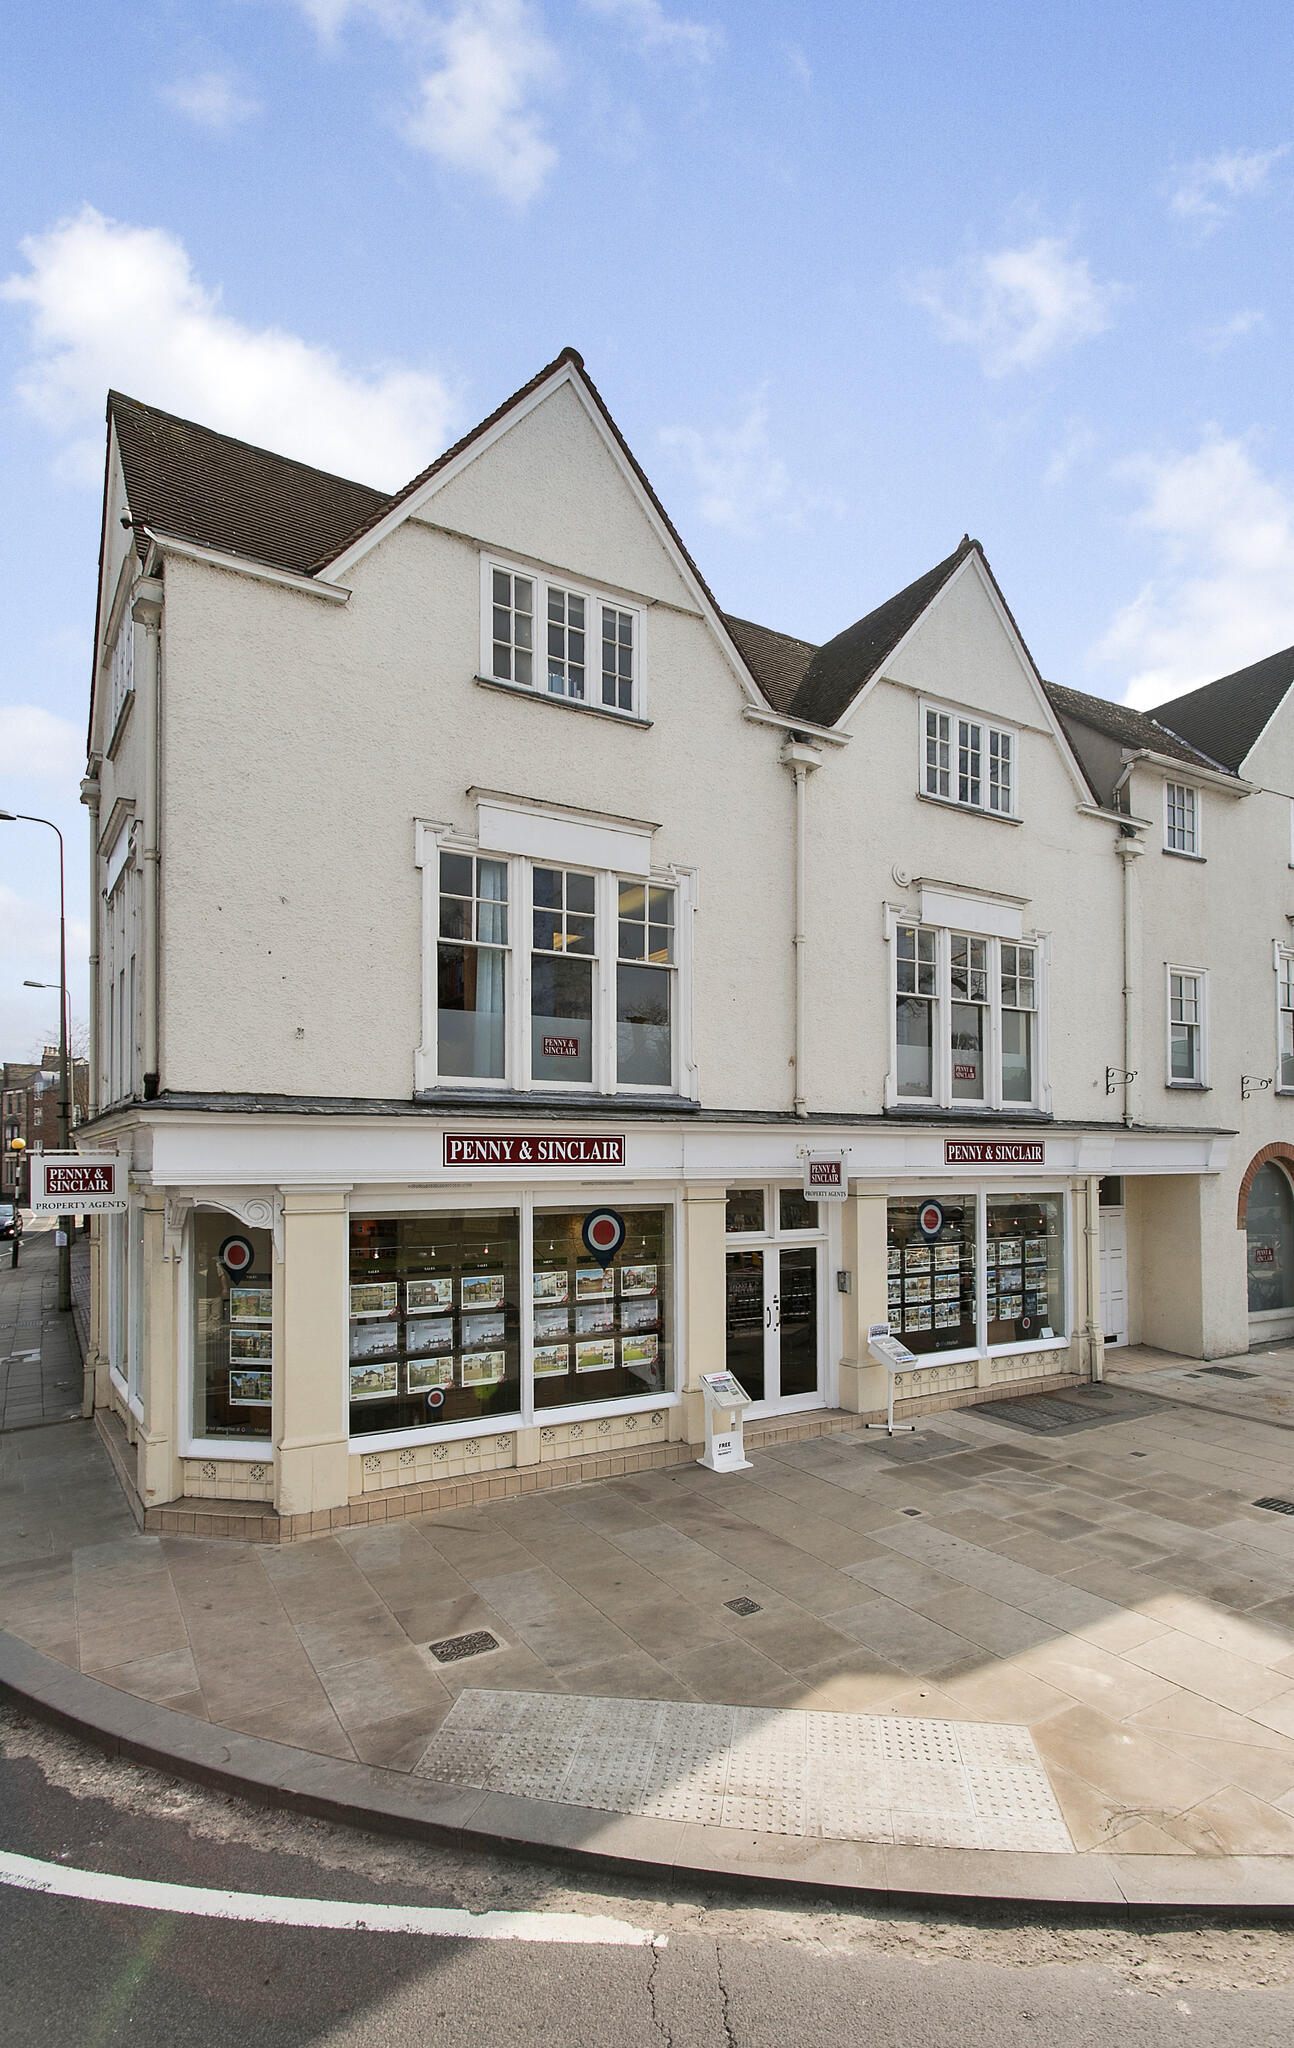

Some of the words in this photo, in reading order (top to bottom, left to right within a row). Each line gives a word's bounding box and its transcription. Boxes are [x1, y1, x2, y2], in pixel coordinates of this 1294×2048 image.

[544, 1038, 567, 1047] PENNY
[568, 1039, 574, 1047] &
[544, 1046, 577, 1056] SINCLAIR
[450, 1140, 514, 1160] PENNY
[518, 1140, 533, 1161] &
[537, 1141, 621, 1161] SINCLAIR
[948, 1145, 983, 1160] PENNY
[985, 1145, 994, 1160] &
[995, 1145, 1042, 1160] SINCLAIR
[49, 1168, 91, 1180] PENNY
[94, 1168, 104, 1180] &
[811, 1164, 831, 1174] PENNY
[831, 1164, 837, 1174] &
[811, 1173, 839, 1183] SINCLAIR
[49, 1180, 109, 1192] SINCLAIR
[35, 1201, 87, 1210] PROPERTY
[88, 1200, 127, 1209] AGENTS
[718, 1441, 731, 1449] FREE
